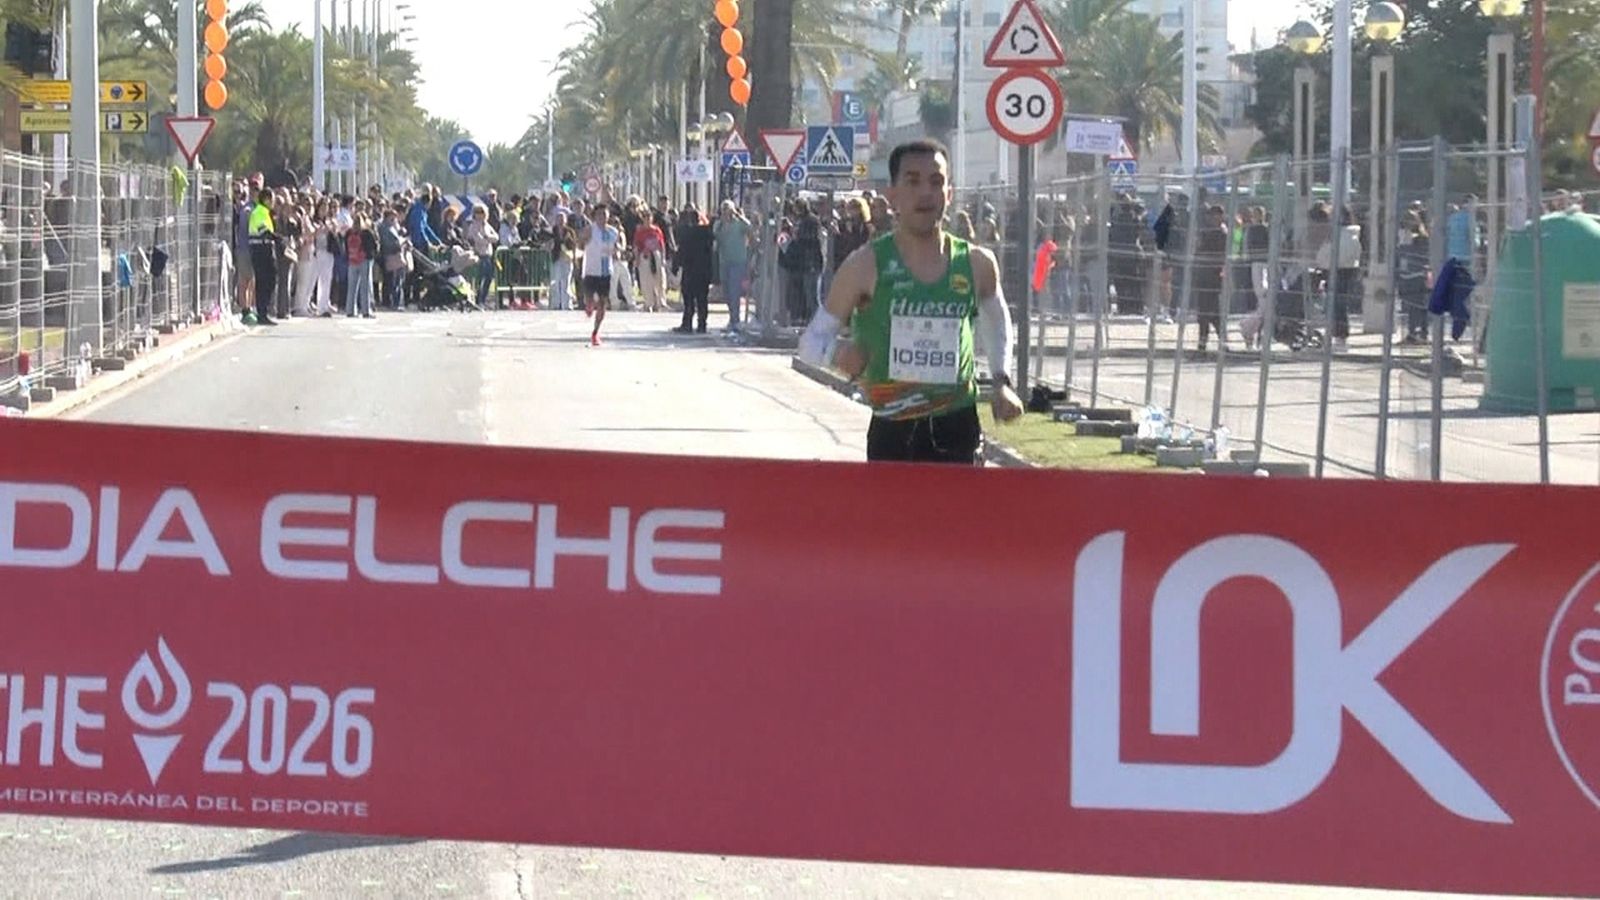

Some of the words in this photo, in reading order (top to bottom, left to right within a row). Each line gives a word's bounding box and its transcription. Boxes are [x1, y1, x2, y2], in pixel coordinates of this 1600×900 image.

[1005, 93, 1045, 118] 30
[889, 298, 967, 317] Huesca
[893, 347, 957, 367] 10989
[0, 482, 231, 576] DIA
[261, 494, 725, 595] ELCHE
[1563, 603, 1600, 706] PO
[0, 673, 107, 769] HE
[203, 682, 375, 778] 2026
[196, 795, 244, 812] DEL
[252, 798, 368, 818] DEPORTE
